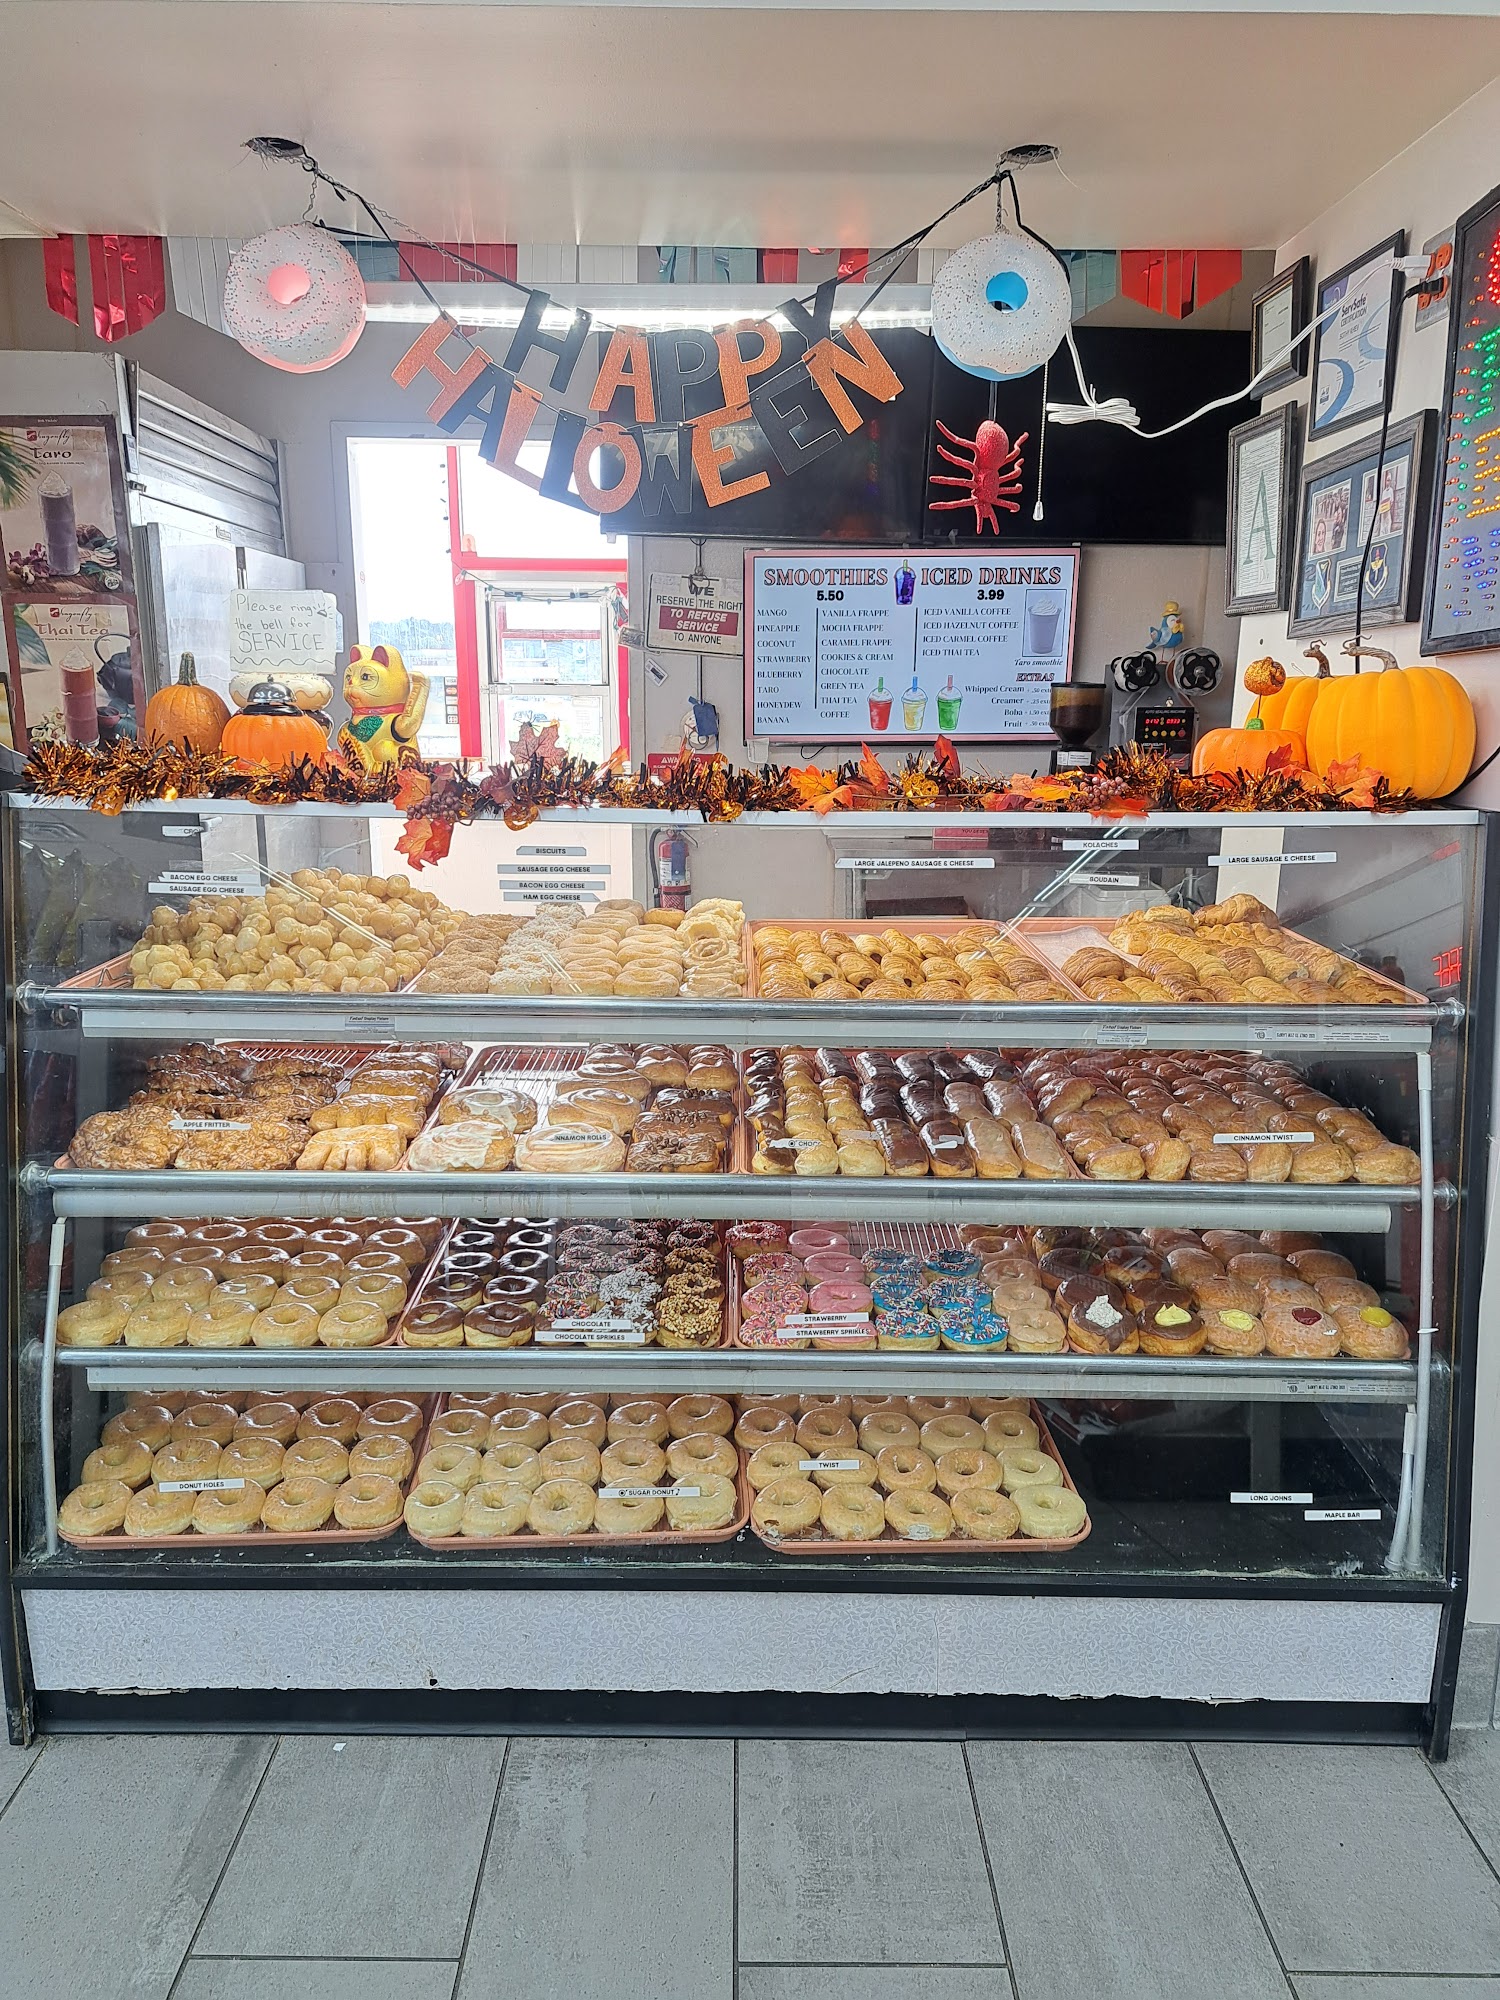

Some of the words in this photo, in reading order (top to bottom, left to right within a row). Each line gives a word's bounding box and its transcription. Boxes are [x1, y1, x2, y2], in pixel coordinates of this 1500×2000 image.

[503, 277, 839, 424] HAPPY
[391, 310, 904, 517] HALLOWEEN
[30, 447, 72, 459] Taro
[1243, 470, 1275, 565] A
[763, 568, 888, 586] SMOOTHIES
[921, 567, 973, 586] ICED
[978, 566, 1062, 585] DRINKS
[689, 584, 714, 596] WE
[816, 590, 844, 601] 5.50
[976, 589, 1005, 600] 3.99
[236, 593, 282, 612] Please
[290, 603, 313, 617] ring
[656, 595, 694, 607] RESERVE
[699, 599, 714, 609] THE
[718, 600, 743, 611] RIGHT
[670, 608, 684, 618] TO
[687, 611, 728, 622] REFUSE
[822, 609, 857, 617] VANILLA
[858, 609, 890, 617] FRAPPE
[923, 608, 943, 616] ICED
[944, 608, 979, 616] VANILLA
[235, 617, 253, 630] the
[261, 619, 283, 630] bell
[290, 617, 311, 628] for
[676, 620, 719, 632] SERVICE
[821, 624, 852, 632] MOCHA
[853, 624, 884, 632] FRAPPE
[34, 623, 73, 636] Thai
[76, 624, 110, 635] Tea
[239, 630, 324, 653] SERVICE
[674, 632, 684, 641] TO
[688, 634, 721, 645] ANYONE
[757, 640, 796, 648] COCONUT
[923, 635, 942, 643] ICED
[821, 653, 856, 661] COOKIES
[865, 653, 894, 661] CREAM
[757, 671, 803, 679] BLUEBERRY
[1016, 673, 1055, 682] EXTRAS
[757, 686, 779, 694] TARO
[820, 682, 847, 690] GREEN
[849, 682, 865, 690] TEA
[965, 685, 999, 694] Whipped
[999, 685, 1024, 693] Cream
[757, 701, 802, 709] HONEYDEW
[757, 716, 790, 724] BANANA
